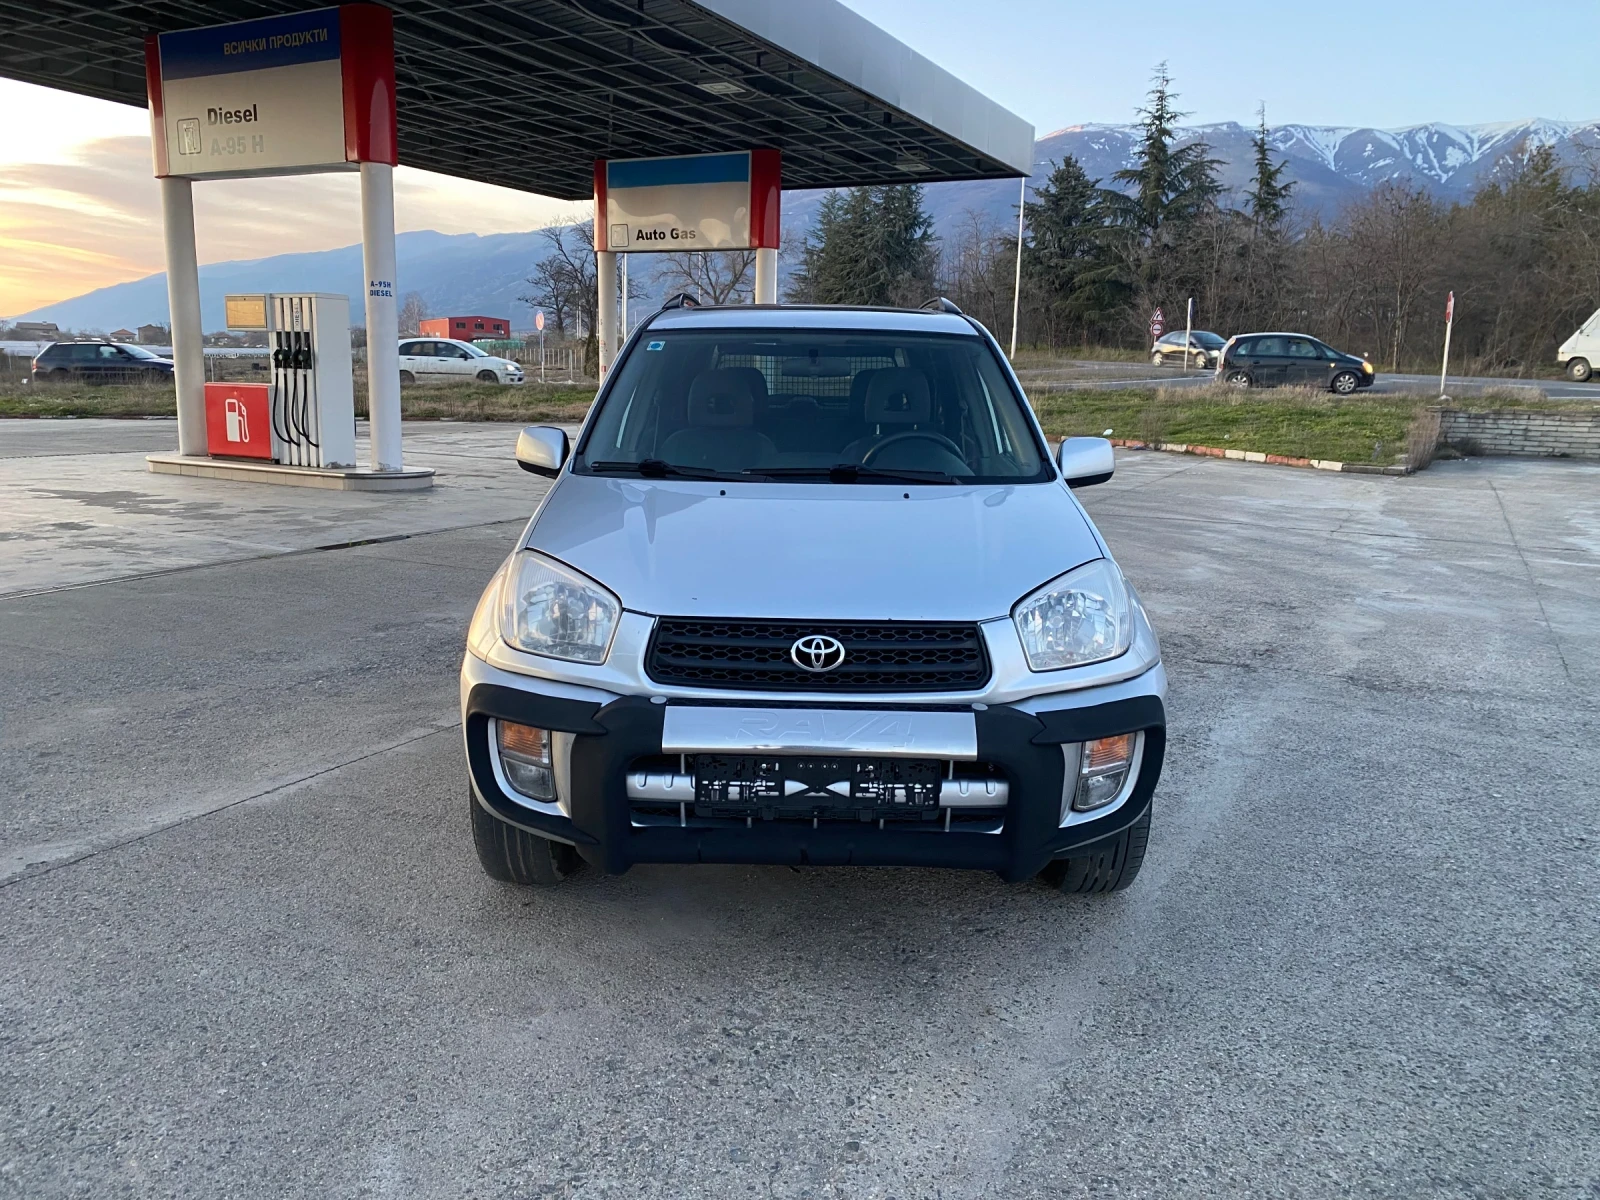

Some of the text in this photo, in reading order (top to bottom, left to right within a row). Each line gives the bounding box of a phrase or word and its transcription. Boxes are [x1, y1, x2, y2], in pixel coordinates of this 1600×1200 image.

[223, 28, 328, 55] ВСИЧКИ ПРОДУКТИ
[207, 103, 258, 126] Diesel
[636, 227, 696, 241] Auto Gas
[370, 289, 393, 297] DIESEL
[725, 711, 915, 747] RAV4
